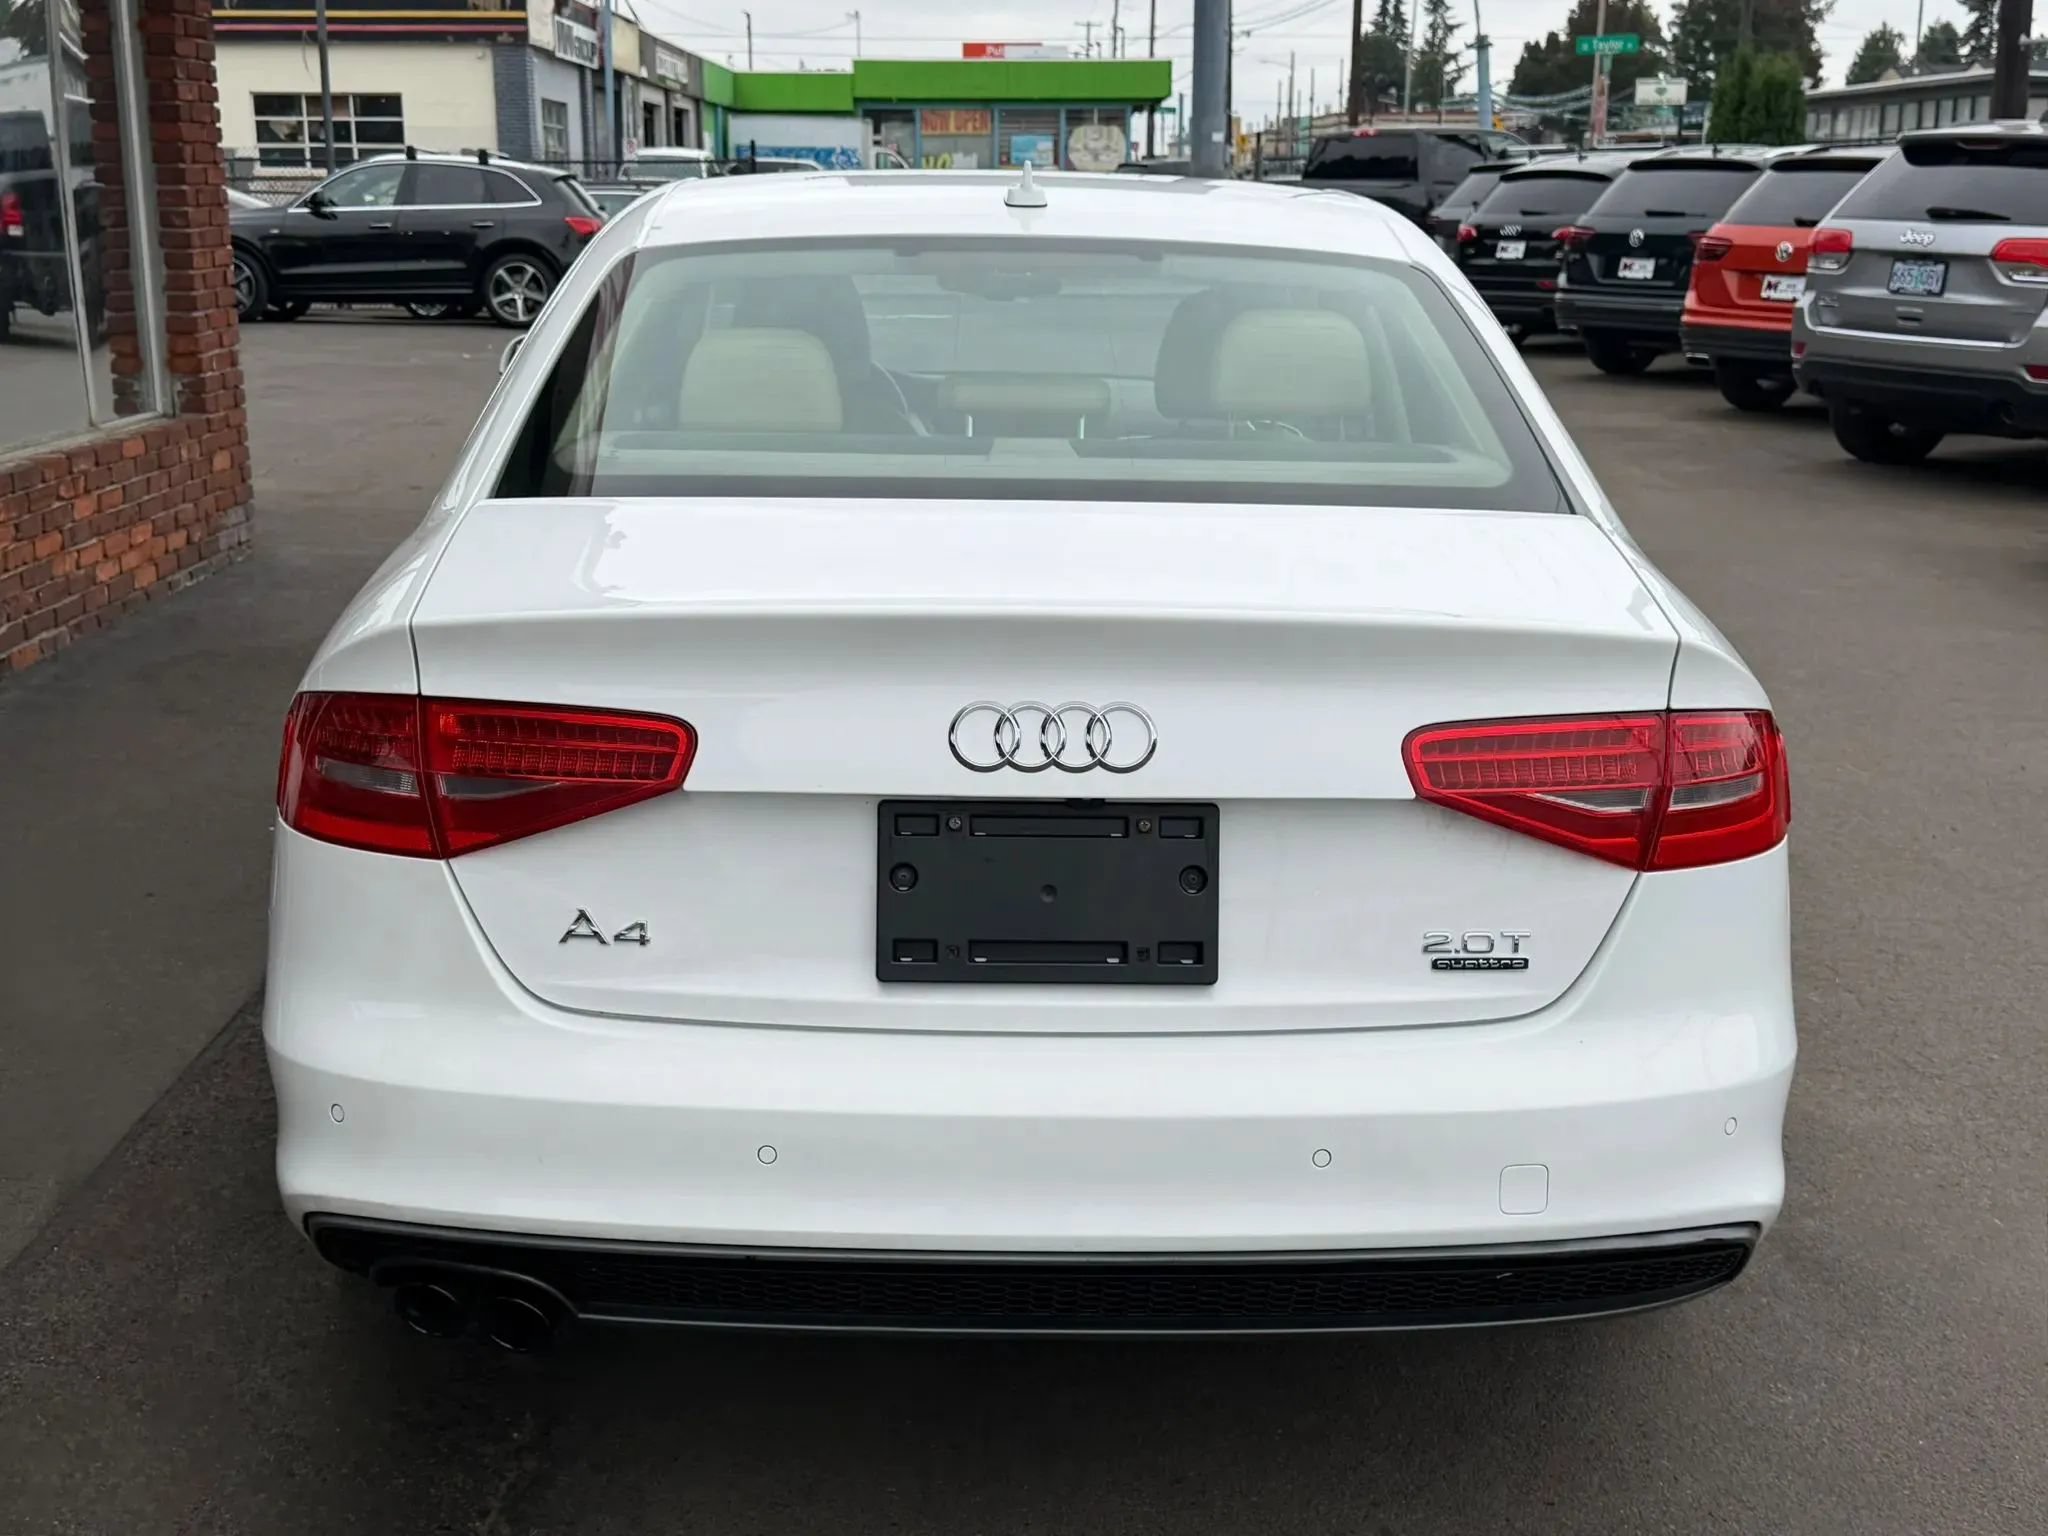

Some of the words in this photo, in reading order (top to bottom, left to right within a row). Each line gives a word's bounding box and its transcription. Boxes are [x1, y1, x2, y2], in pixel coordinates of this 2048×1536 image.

[1592, 39, 1624, 51] Taylor
[954, 109, 989, 132] OPEN
[1899, 229, 1935, 247] Jeep
[559, 907, 651, 945] A4
[1435, 958, 1526, 971] quattro
